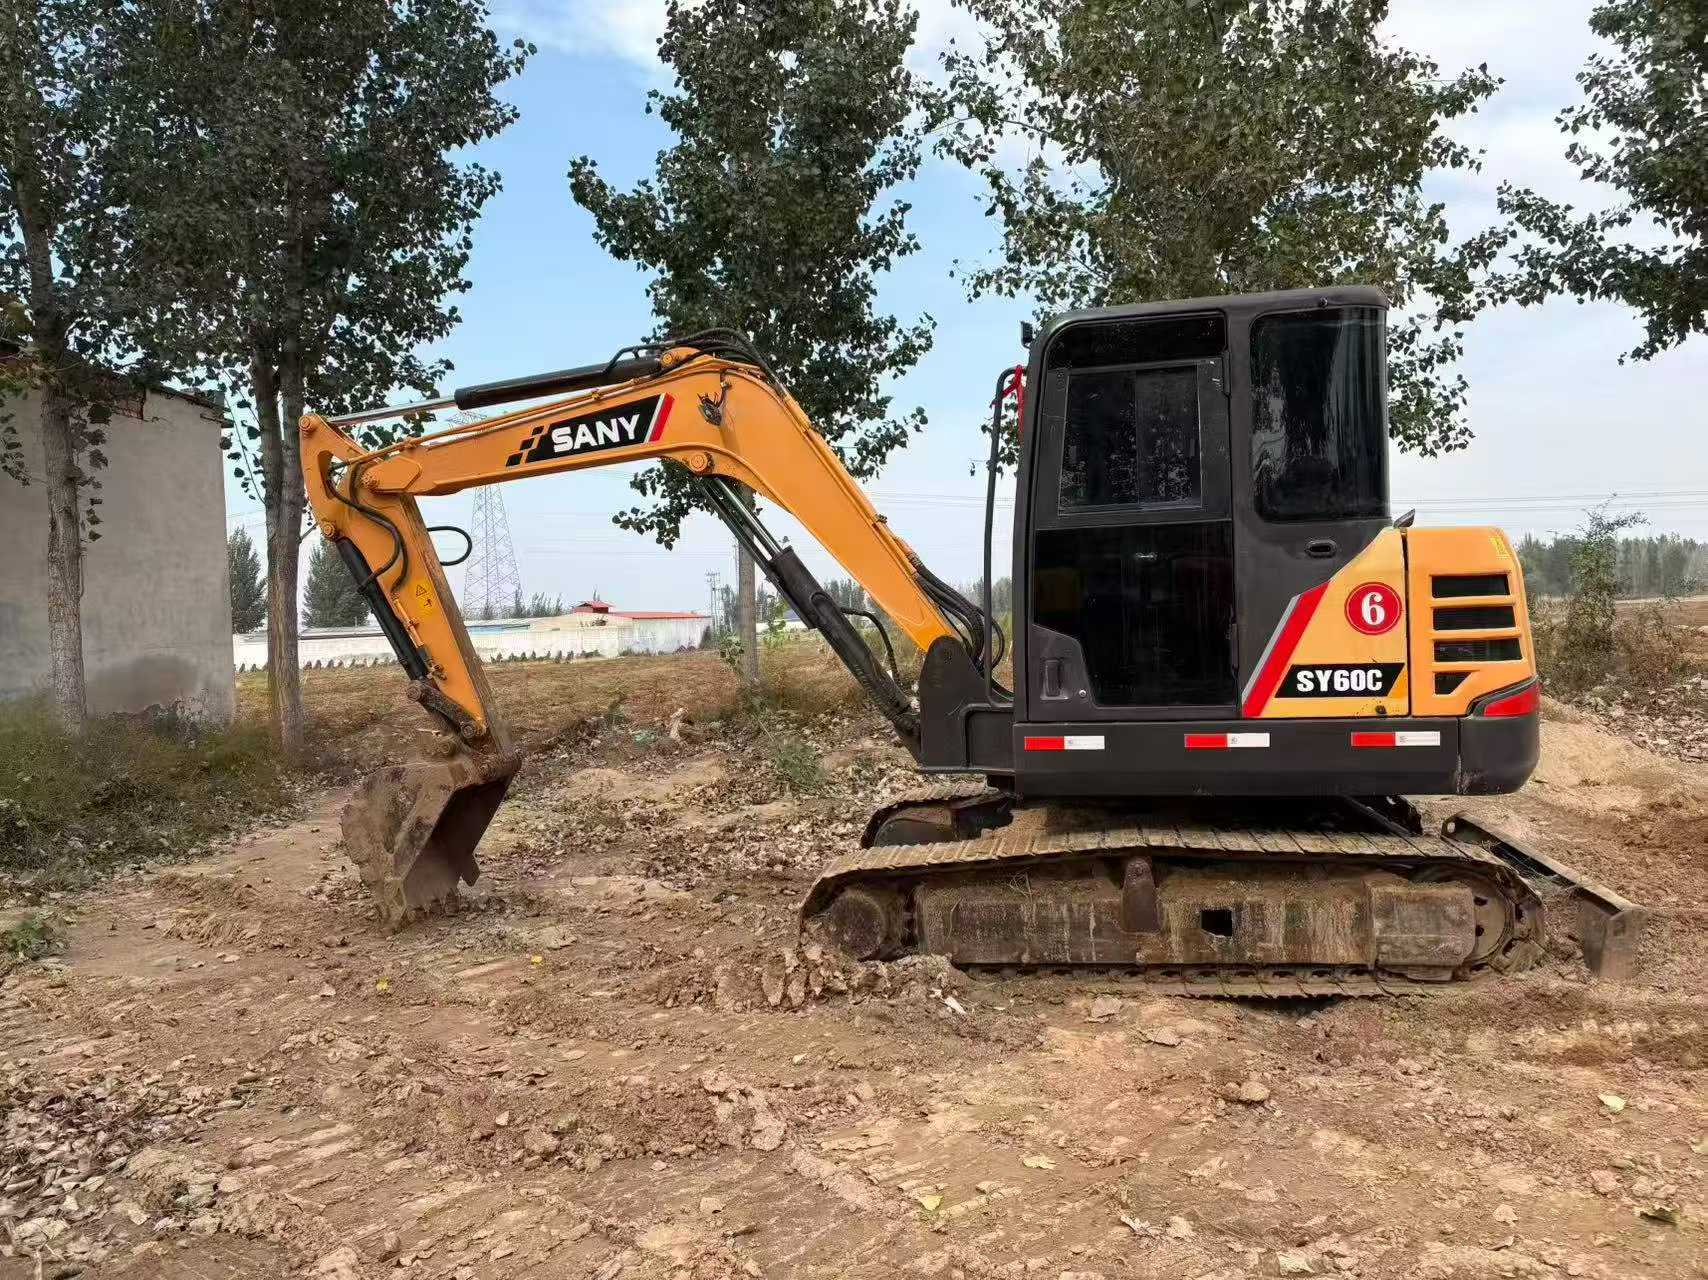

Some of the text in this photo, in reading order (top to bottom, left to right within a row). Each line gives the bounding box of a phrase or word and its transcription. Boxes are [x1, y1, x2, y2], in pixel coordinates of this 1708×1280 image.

[551, 414, 641, 453] SANY
[1361, 591, 1386, 626] 6
[1296, 669, 1383, 692] SY60C
